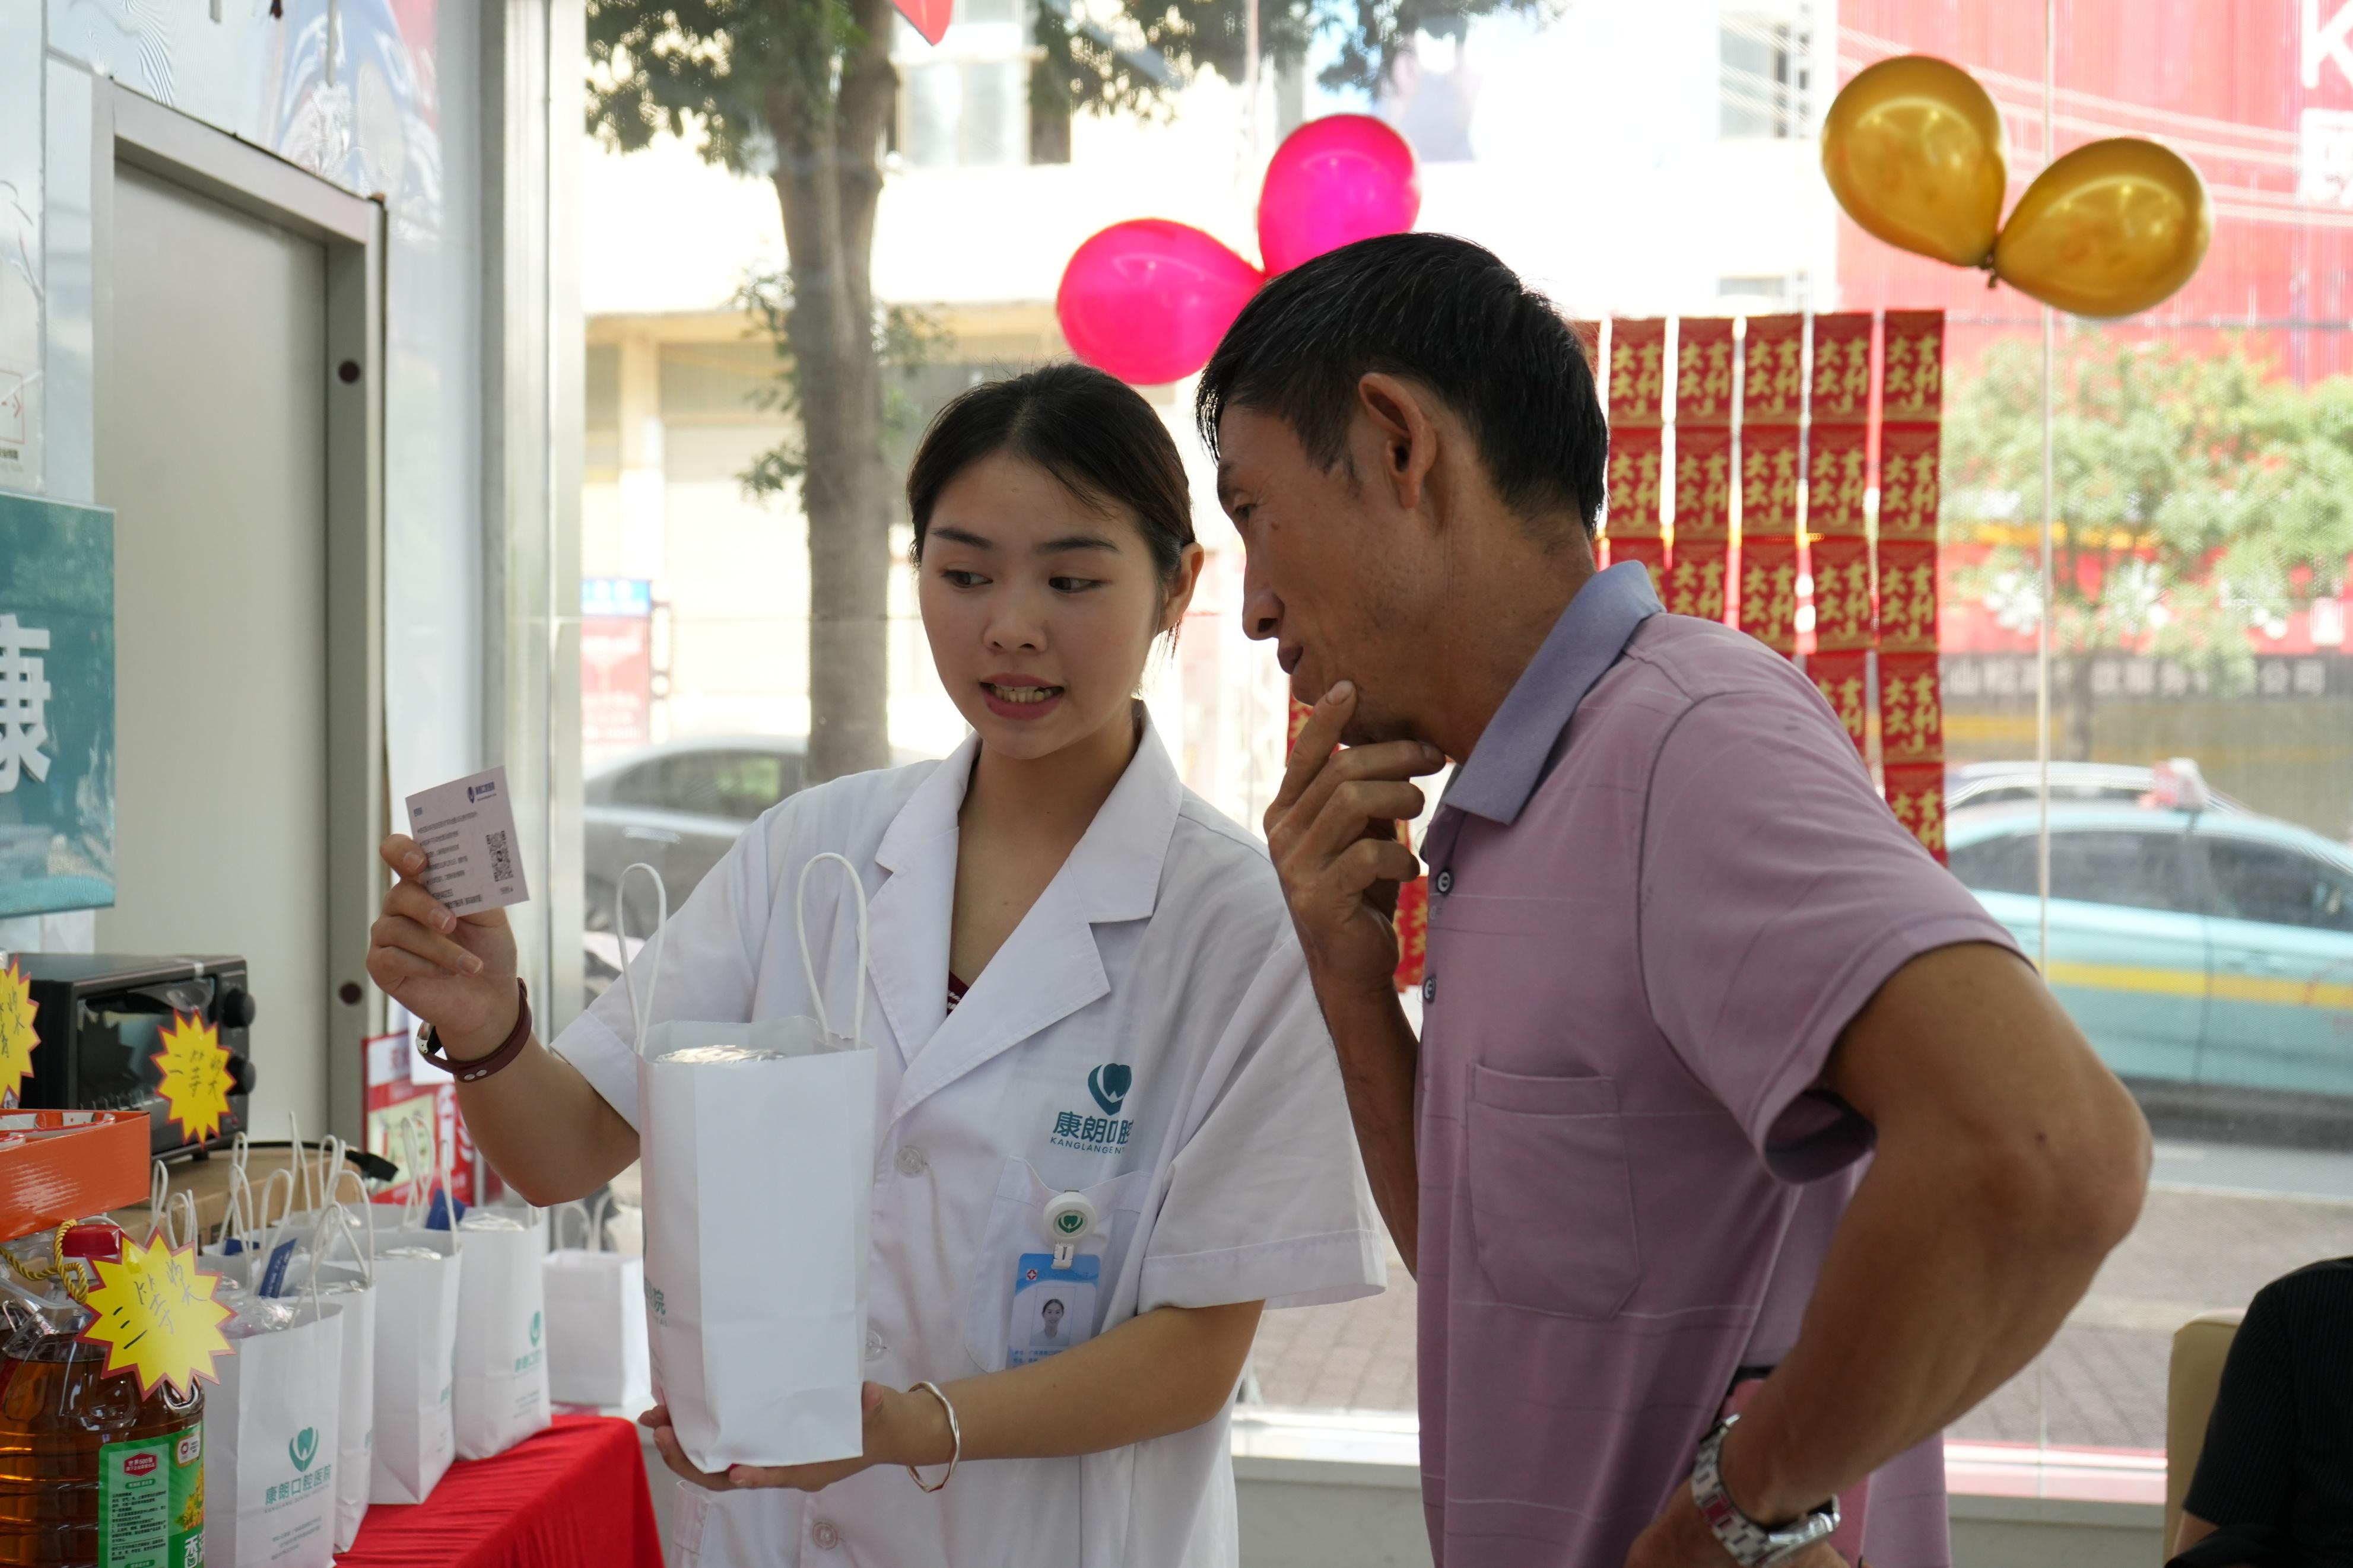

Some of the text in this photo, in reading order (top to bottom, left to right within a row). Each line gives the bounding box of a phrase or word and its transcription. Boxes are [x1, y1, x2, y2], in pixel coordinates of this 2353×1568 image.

[265, 1464, 332, 1506] 康朗口腔医院
